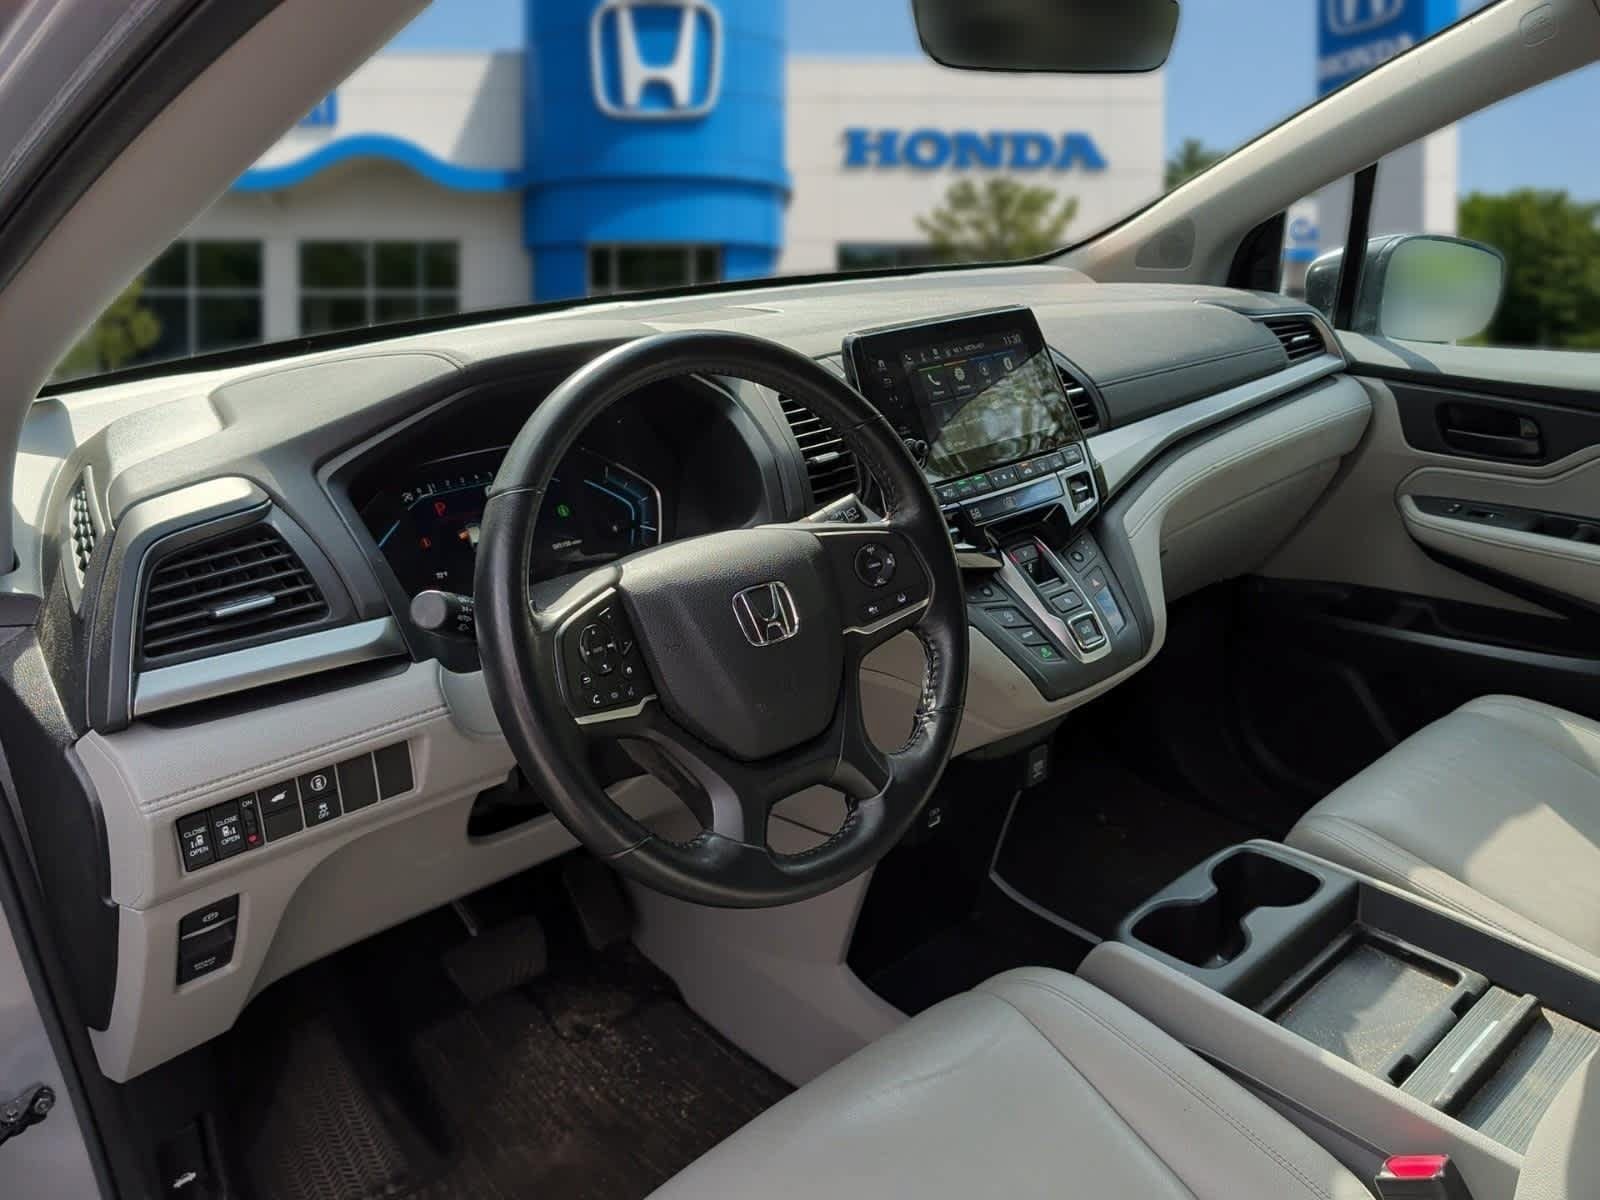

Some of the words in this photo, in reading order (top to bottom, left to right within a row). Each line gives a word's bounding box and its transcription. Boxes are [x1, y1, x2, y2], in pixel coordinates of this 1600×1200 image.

[843, 126, 1107, 172] HONDA
[215, 815, 239, 828] CLOSE
[183, 826, 207, 839] CLOSE
[221, 834, 241, 846] OPEN
[189, 845, 209, 857] OPEN
